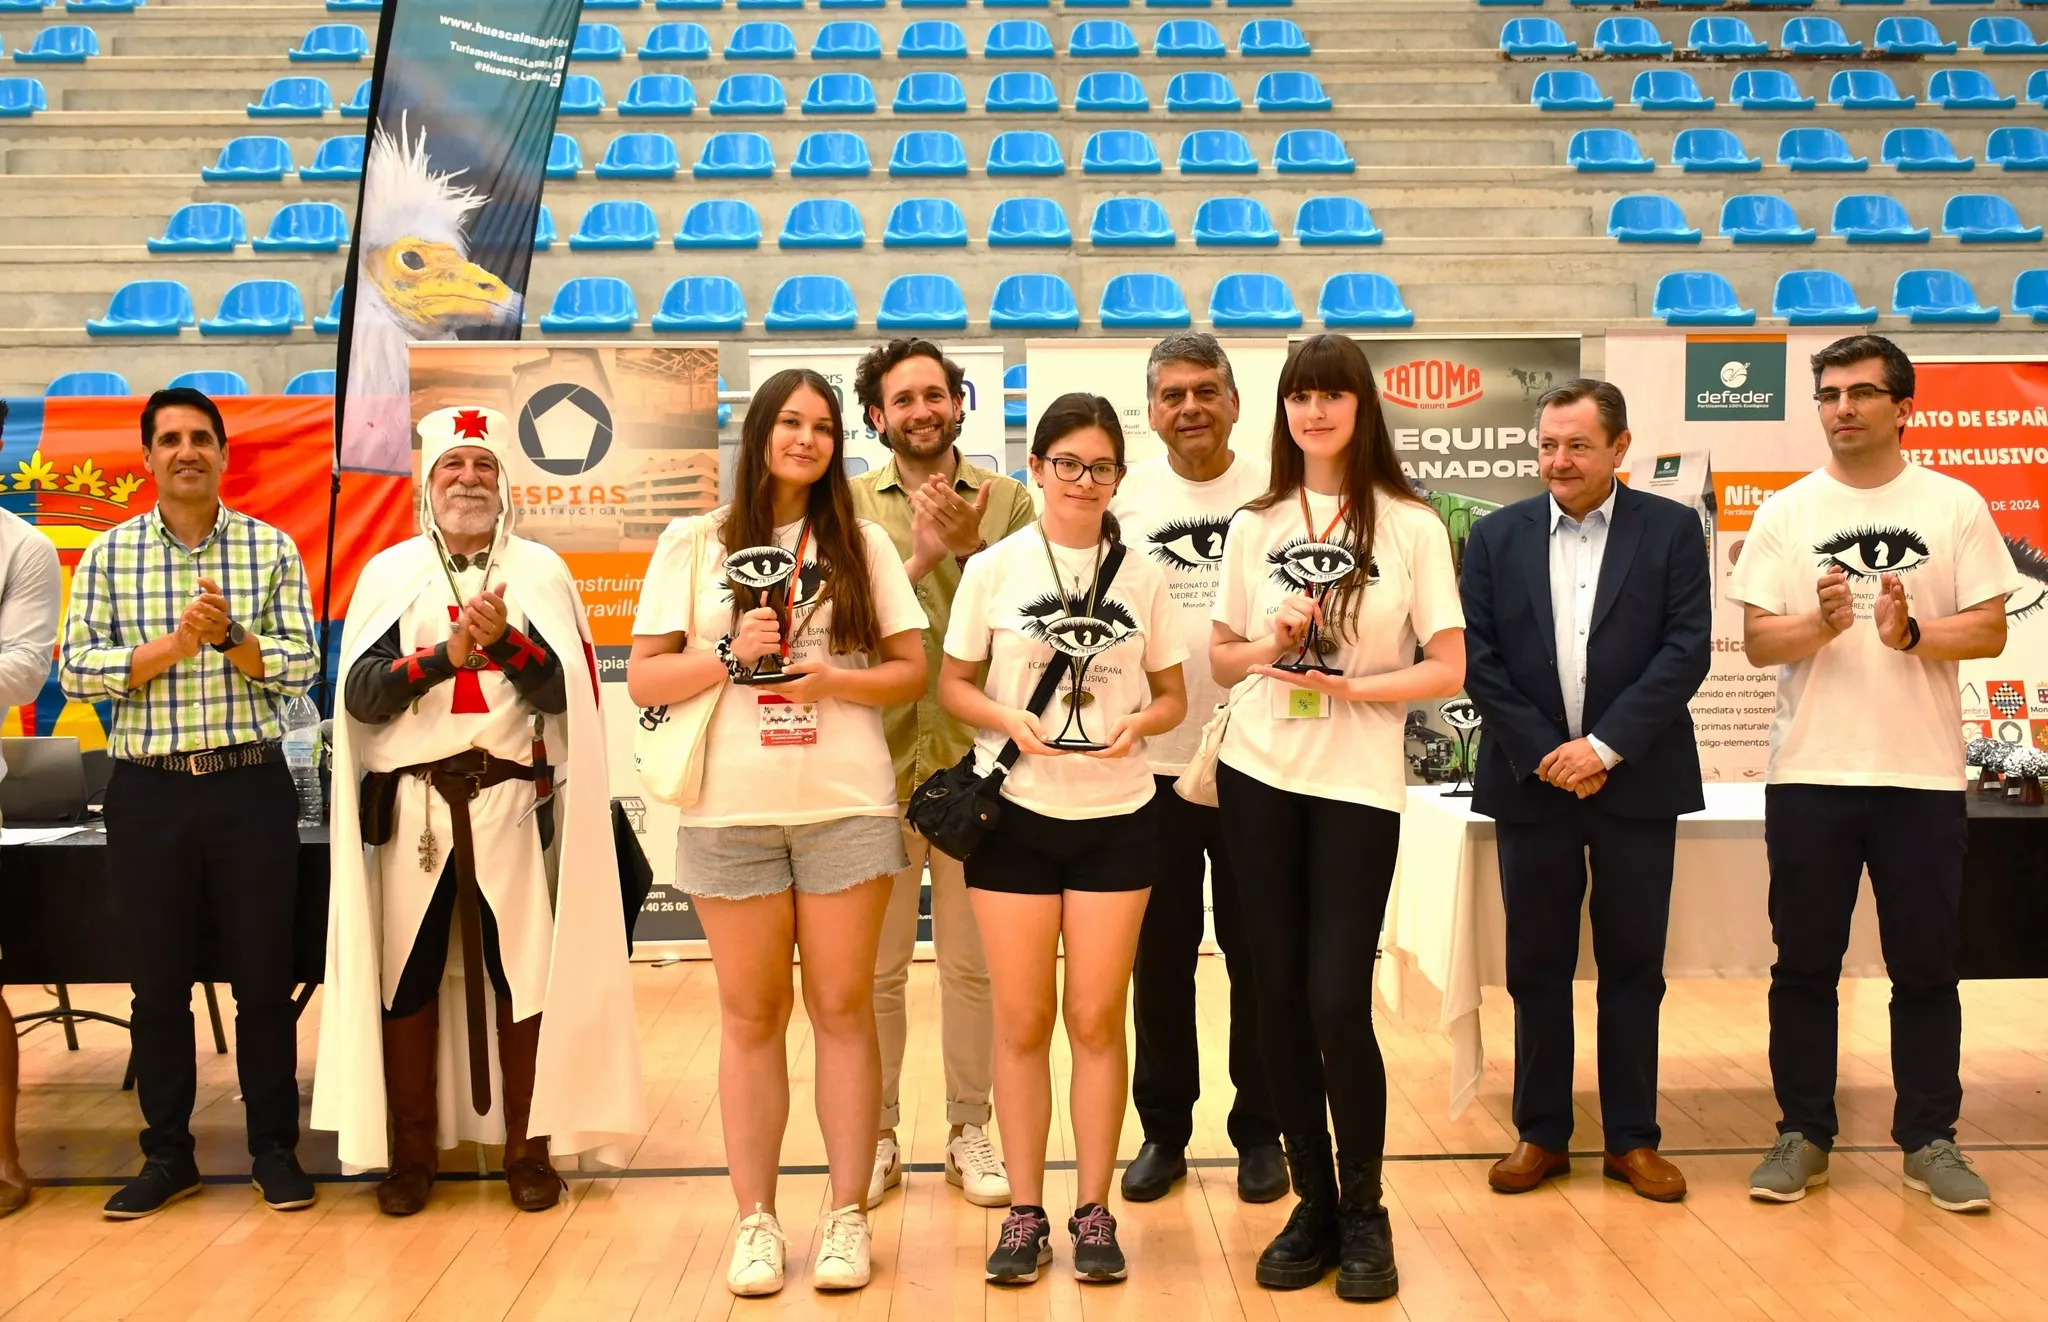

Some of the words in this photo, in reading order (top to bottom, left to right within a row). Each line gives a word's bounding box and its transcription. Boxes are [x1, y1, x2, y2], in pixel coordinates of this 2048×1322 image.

[1383, 360, 1481, 400] TATOMA
[1697, 391, 1774, 404] defeder
[1957, 410, 1982, 428] DE
[1937, 448, 2048, 466] INCLUSIVO
[1991, 501, 2006, 511] DE
[2009, 500, 2040, 511] 2024
[1094, 664, 1122, 675] ESPAÑA
[1691, 706, 1734, 714] inmediata
[1701, 723, 1731, 731] primas
[1733, 723, 1770, 731] naturale
[1700, 739, 1770, 748] oligo-elementos
[646, 902, 659, 911] 40
[660, 902, 674, 911] 26
[675, 902, 689, 911] 06
